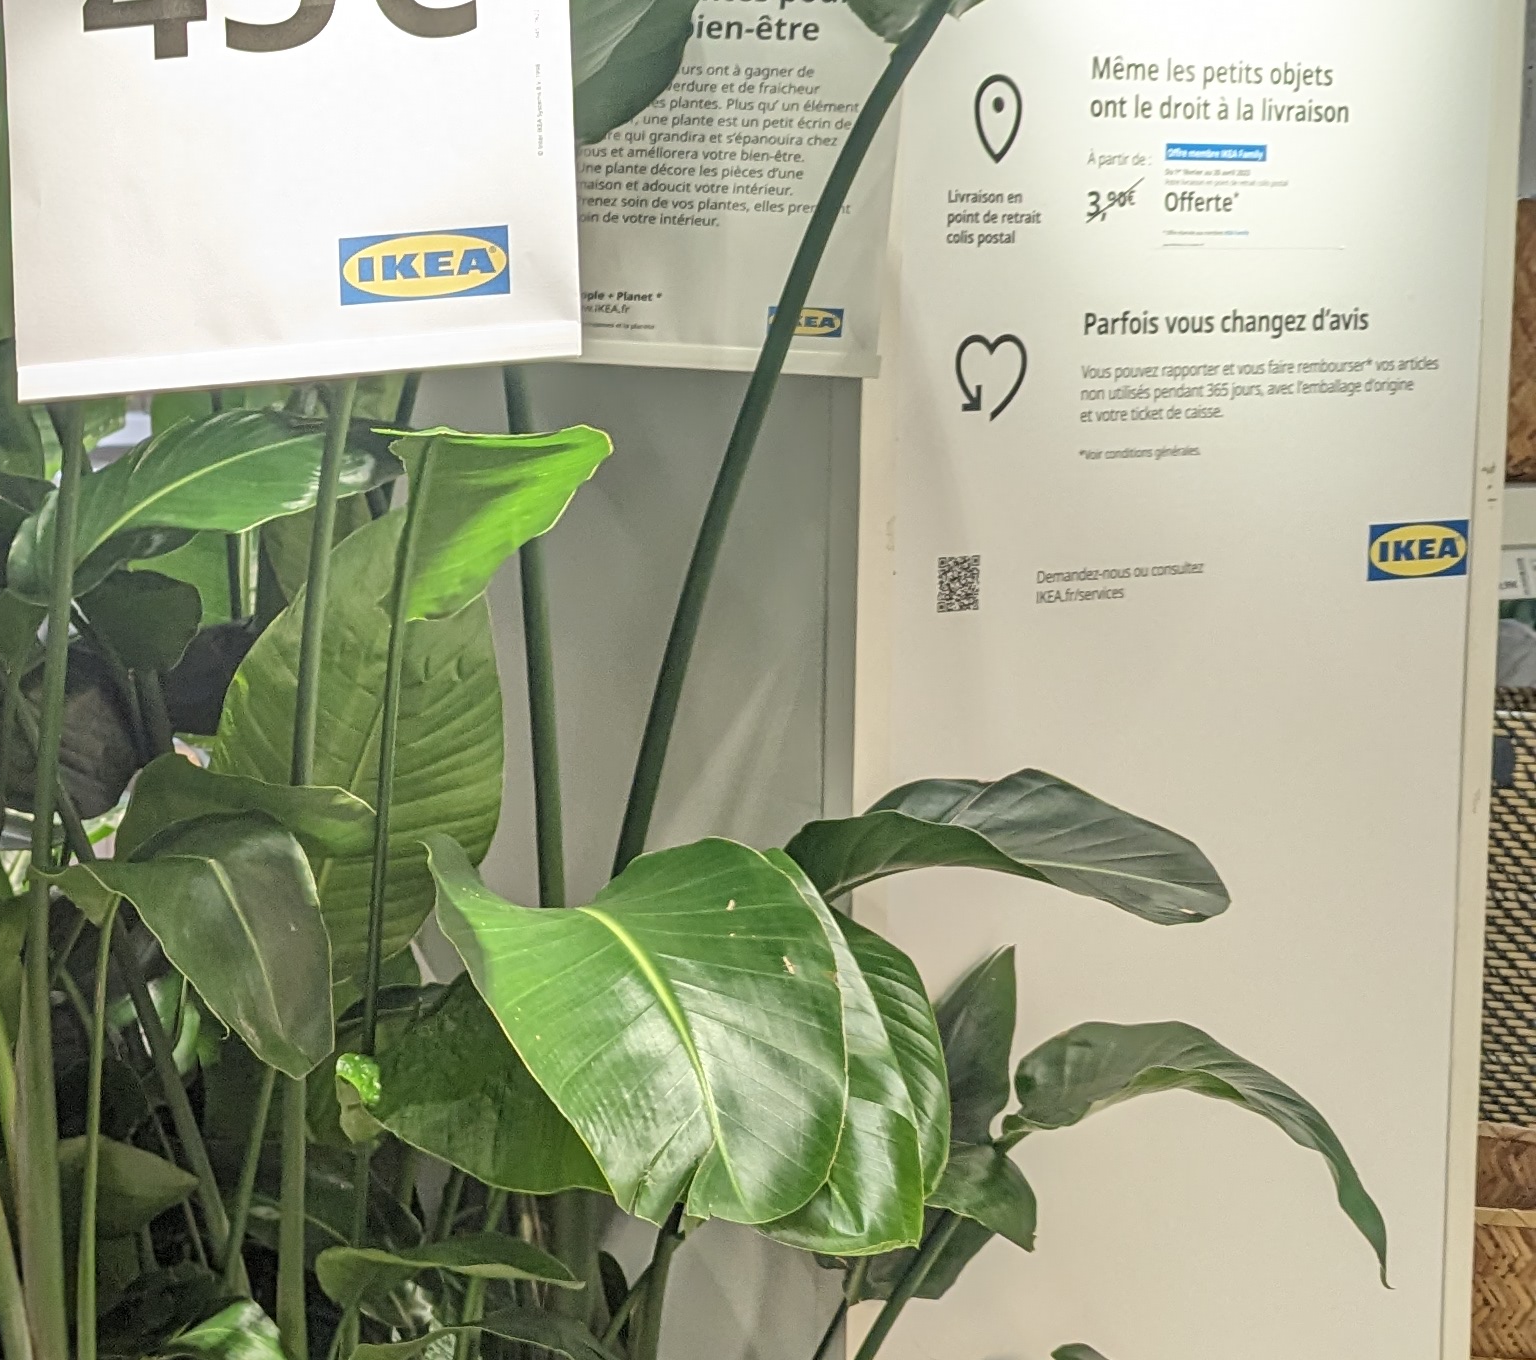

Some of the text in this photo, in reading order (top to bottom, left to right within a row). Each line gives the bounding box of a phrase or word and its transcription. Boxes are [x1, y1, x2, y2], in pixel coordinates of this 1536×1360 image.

[693, 14, 820, 41] ien-être
[706, 64, 729, 76] ont
[744, 66, 794, 80] gagner
[797, 65, 815, 78] de
[1091, 55, 1334, 93] Même les petits objets
[721, 83, 735, 93] et
[738, 82, 755, 94] de
[669, 96, 722, 112] plantes.
[726, 98, 754, 111] Plus
[782, 102, 799, 112] un
[803, 100, 859, 113] élément
[1090, 93, 1350, 123] ont le droit à la livraison
[643, 113, 852, 131] une plante est un petit écrin de
[624, 130, 645, 144] qui
[649, 131, 705, 145] grandira
[709, 134, 723, 144] et
[726, 132, 803, 147] s'épanouira
[807, 134, 838, 147] chez
[610, 146, 805, 163] et améliorera votre bien-être.
[1098, 152, 1146, 169] partir de
[605, 162, 647, 177] plante
[650, 164, 696, 176] décore
[699, 165, 718, 177] les
[721, 166, 763, 180] pièces
[767, 166, 804, 180] d'une
[625, 180, 639, 191] et
[642, 179, 691, 192] adoucit
[694, 183, 729, 194] votre
[732, 183, 794, 197] intérieur.
[947, 189, 1023, 204] Livraison en
[621, 195, 648, 208] soin
[652, 196, 668, 209] de
[672, 198, 694, 209] vos
[697, 199, 750, 213] plantes,
[754, 200, 784, 213] elles
[602, 211, 720, 227] de votre intérieur.
[947, 209, 1042, 227] point de retrait
[946, 230, 1016, 248] colis postal
[358, 248, 496, 283] IKEA
[1083, 306, 1369, 339] Parfois vous changez d'avis
[1081, 364, 1112, 379] Vous
[1114, 365, 1159, 382] pouvez
[1161, 363, 1221, 380] rapporter
[1222, 362, 1237, 376] et
[1237, 362, 1265, 375] vous
[1267, 359, 1294, 375] faire
[1375, 358, 1395, 371] vos
[1397, 355, 1440, 371] articles
[1080, 378, 1414, 402] non utilisés pendant 365 jours, avec l'emballage d'origine
[1079, 405, 1224, 423] et votre ticket de caisse.
[1104, 447, 1153, 459] conditions
[1378, 537, 1459, 563] IKEA
[1036, 561, 1204, 584] Demandez-nous ou consultez
[1035, 586, 1125, 605] IKEA.fr/services
